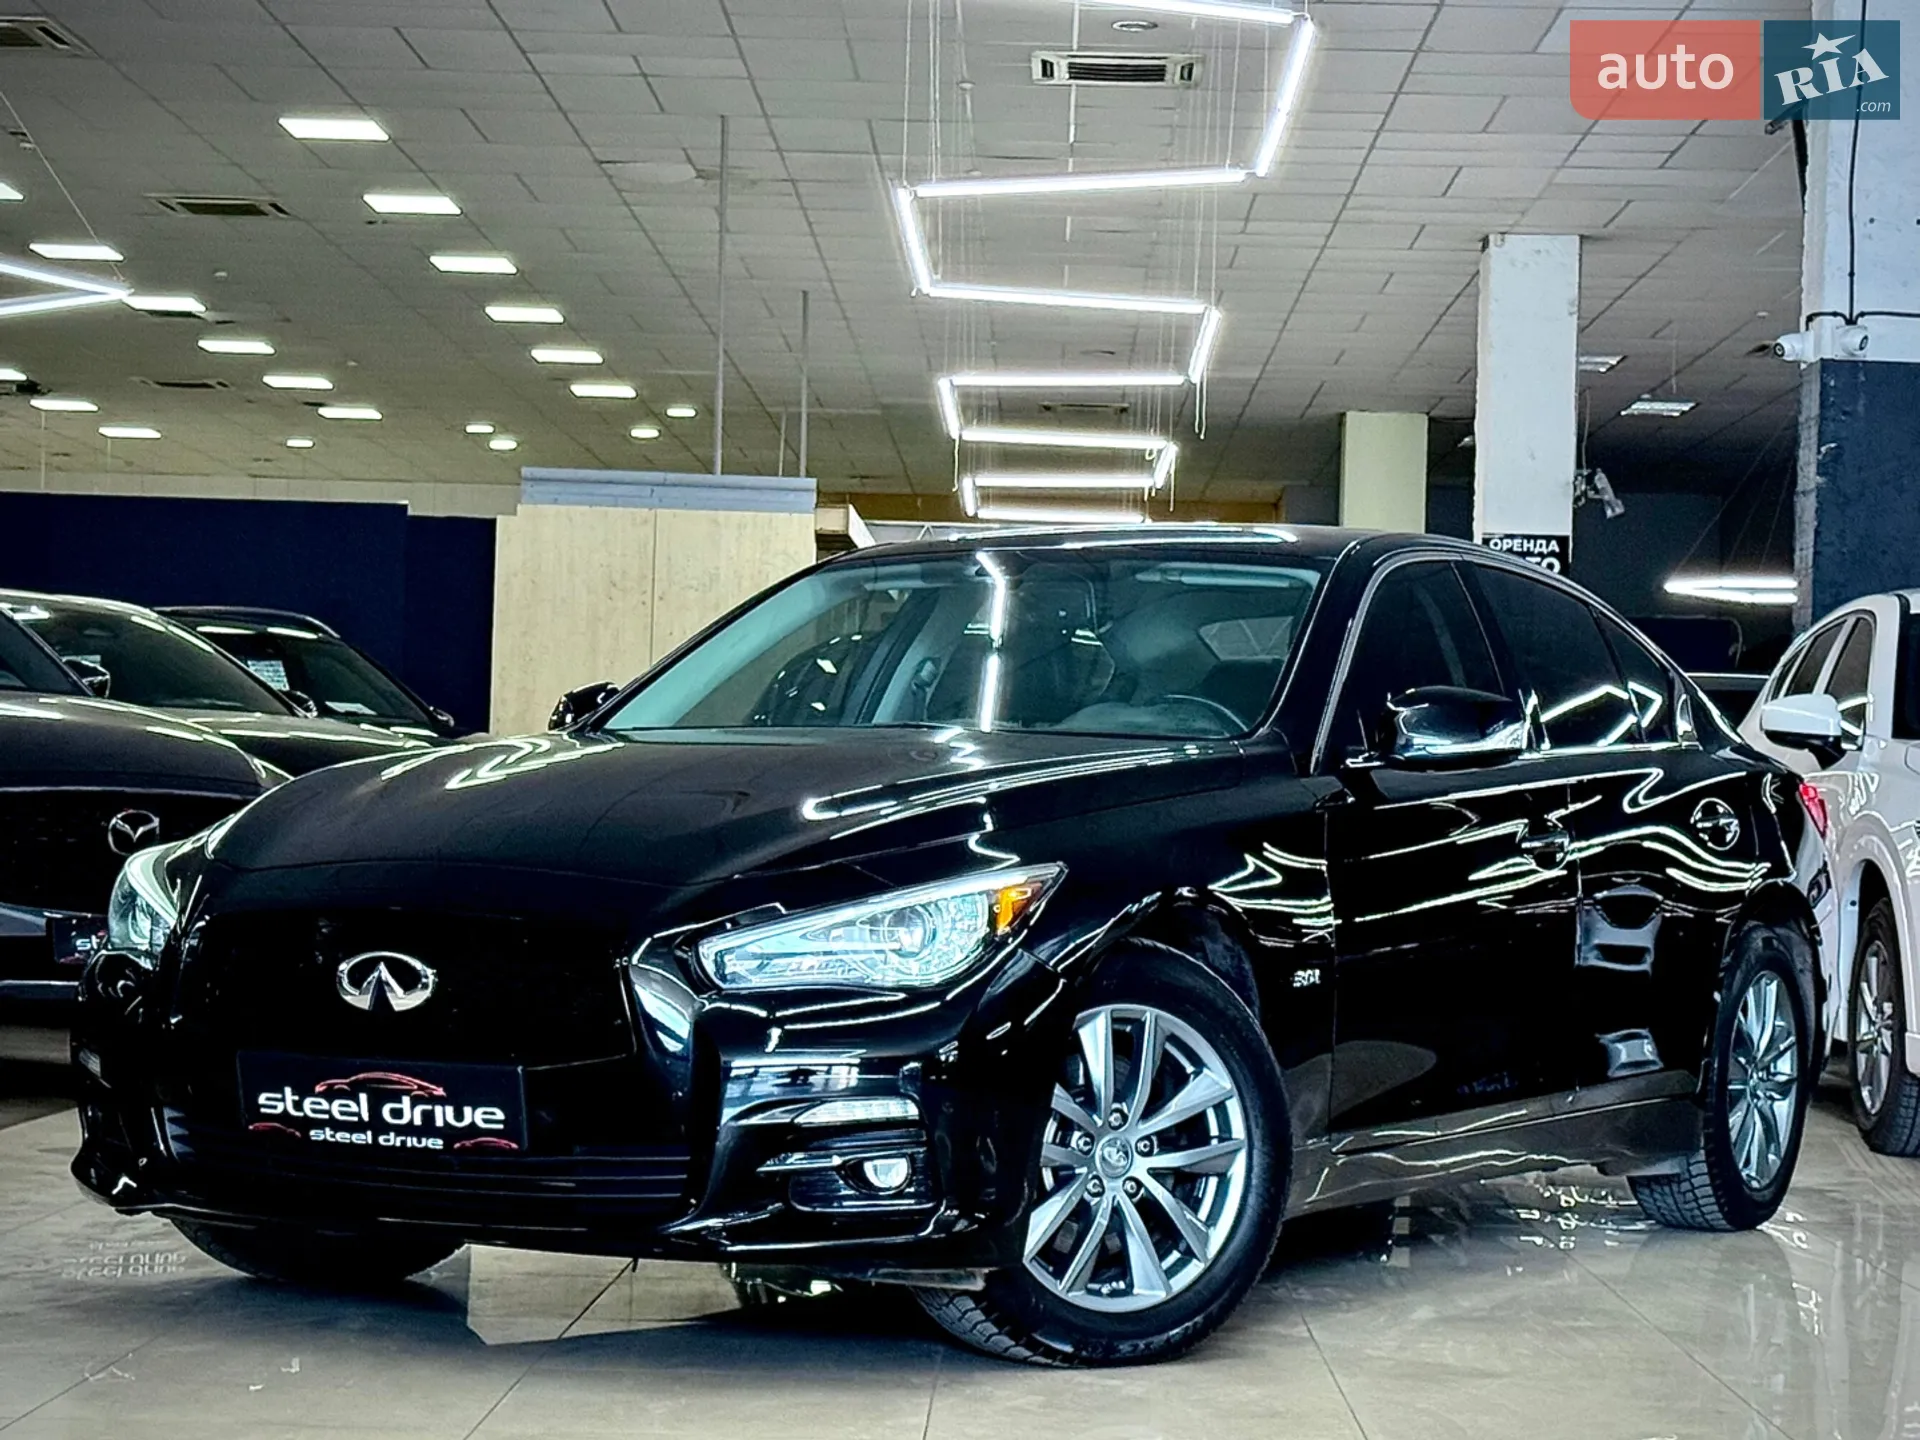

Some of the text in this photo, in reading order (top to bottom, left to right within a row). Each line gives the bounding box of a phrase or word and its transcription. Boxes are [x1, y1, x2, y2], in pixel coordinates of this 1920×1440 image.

[1489, 538, 1560, 554] ОРЕНДА
[257, 1087, 505, 1130] steel drive
[309, 1127, 444, 1149] steel drive
